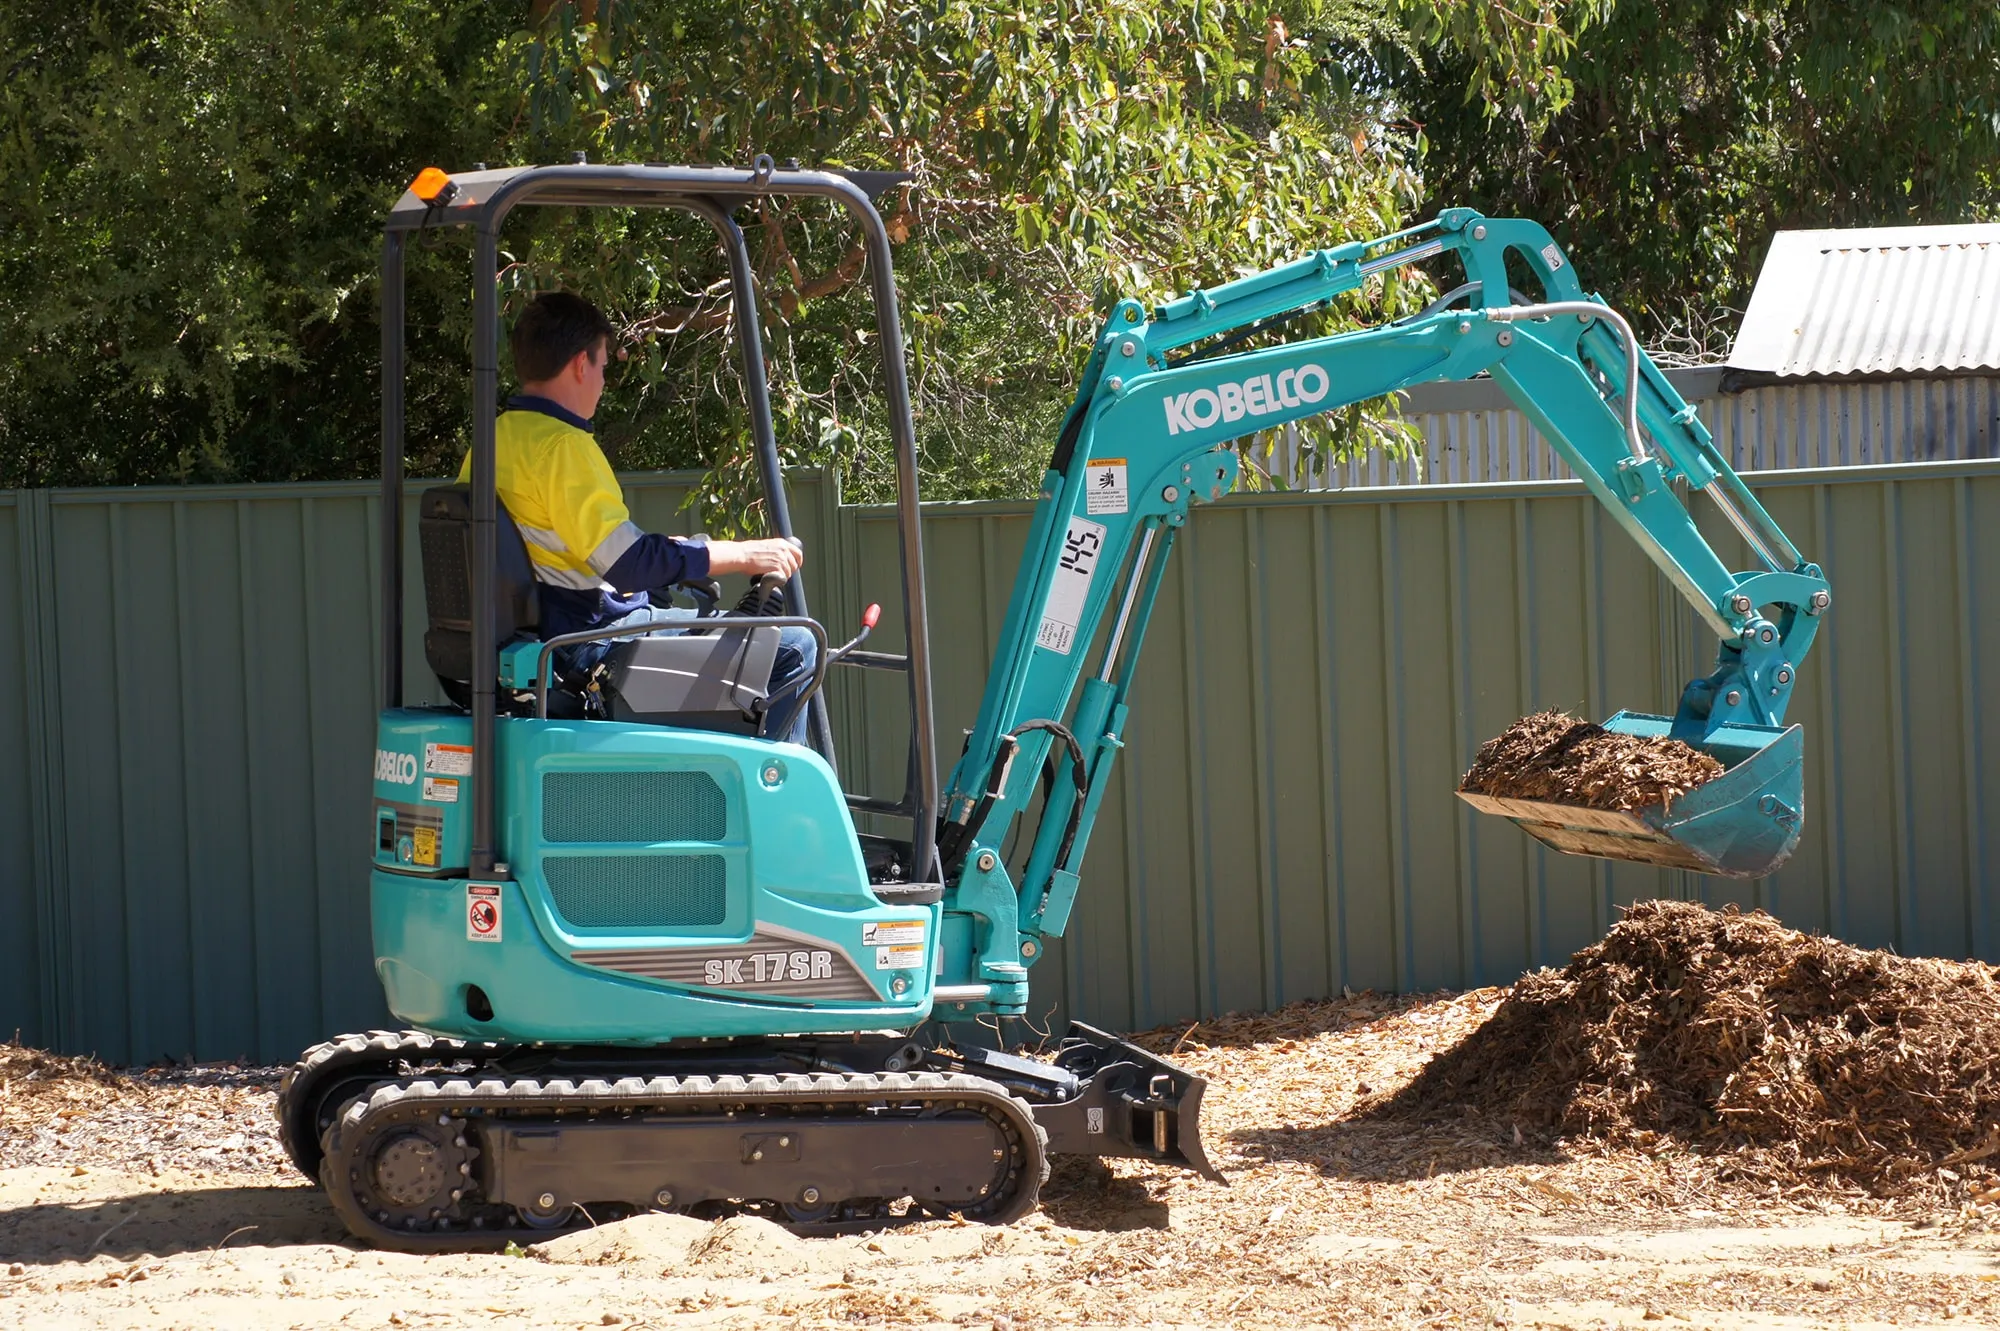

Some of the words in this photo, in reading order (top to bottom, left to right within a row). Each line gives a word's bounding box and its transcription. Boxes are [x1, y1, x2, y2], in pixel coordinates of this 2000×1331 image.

[1163, 363, 1330, 436] KOBELCO
[1060, 529, 1099, 575] 145
[374, 748, 418, 785] OBELCO
